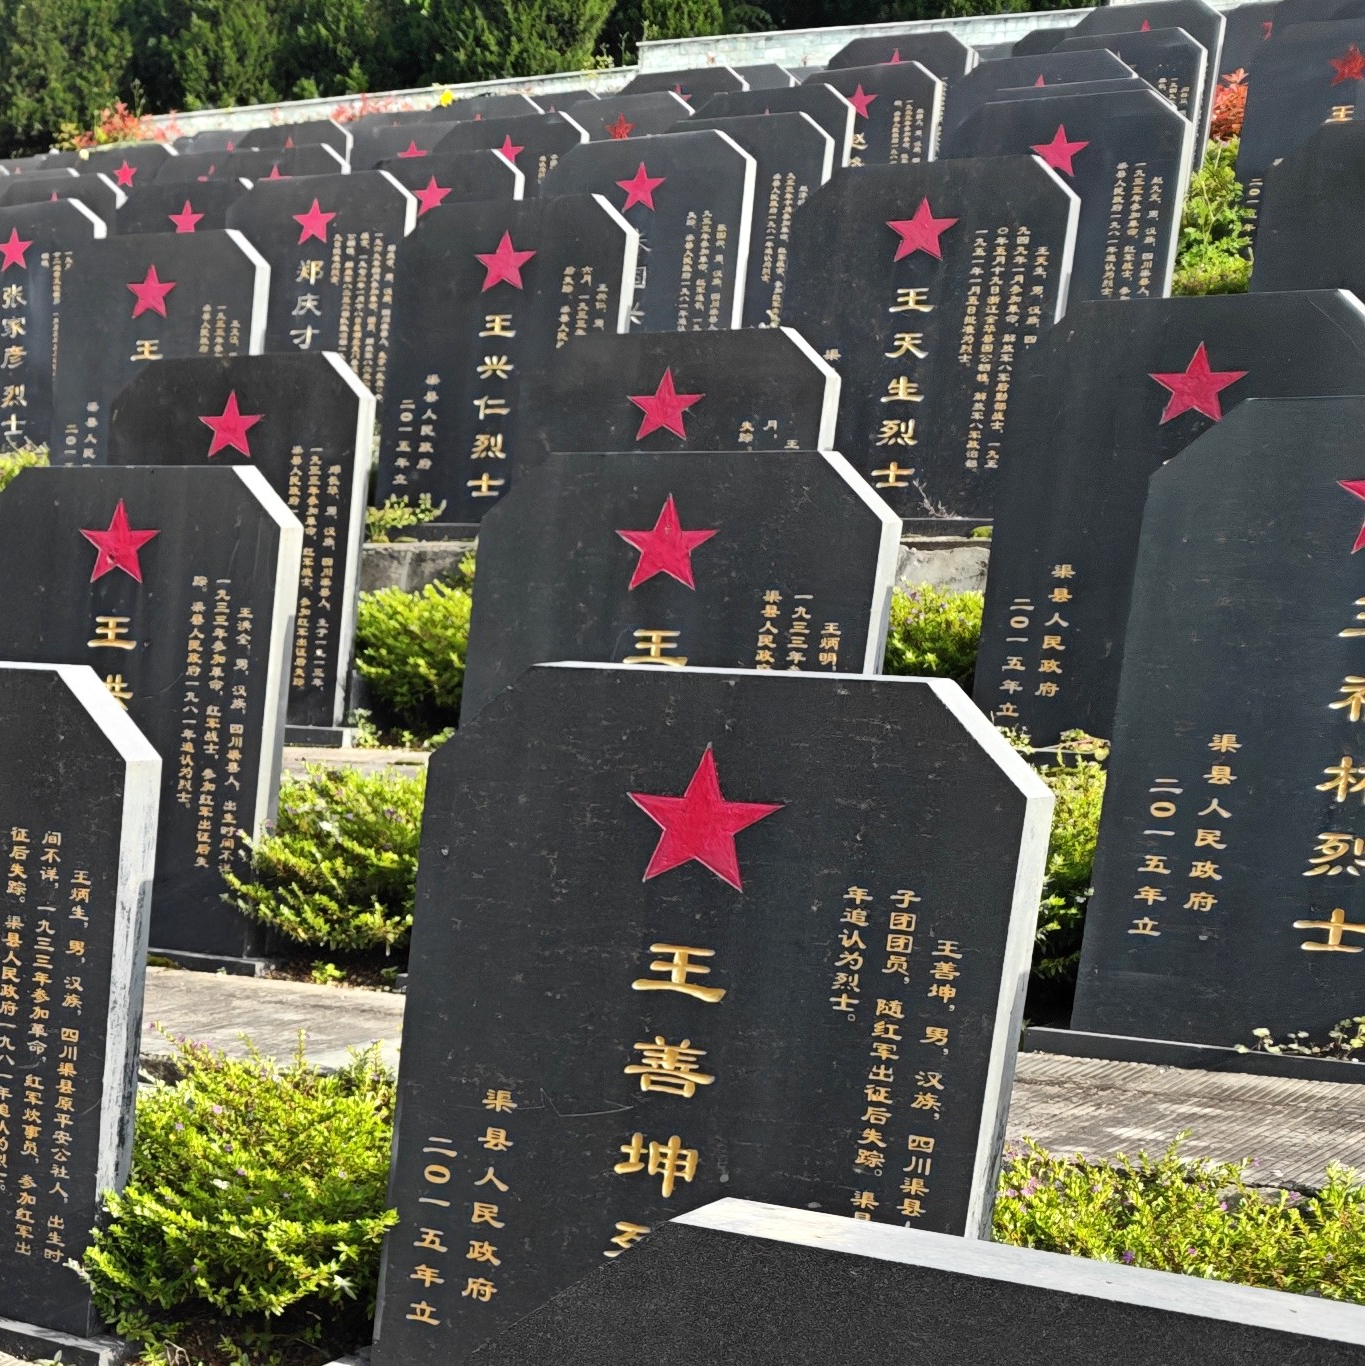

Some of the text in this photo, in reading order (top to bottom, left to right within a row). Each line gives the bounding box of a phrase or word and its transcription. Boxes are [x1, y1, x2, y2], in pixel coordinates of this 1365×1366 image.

[0, 284, 28, 437] 张家彦烈士
[130, 339, 163, 362] 王
[289, 259, 325, 350] 郑庆才
[414, 373, 441, 470] 渠县人民政府
[467, 314, 517, 497] 王兴仁烈士
[870, 287, 936, 489] 王天生烈士
[622, 628, 688, 666] 王
[1035, 563, 1076, 698] 渠县人民政府
[1182, 732, 1243, 913] 渠县人民政府
[461, 1089, 518, 1302] 渠县人民政府
